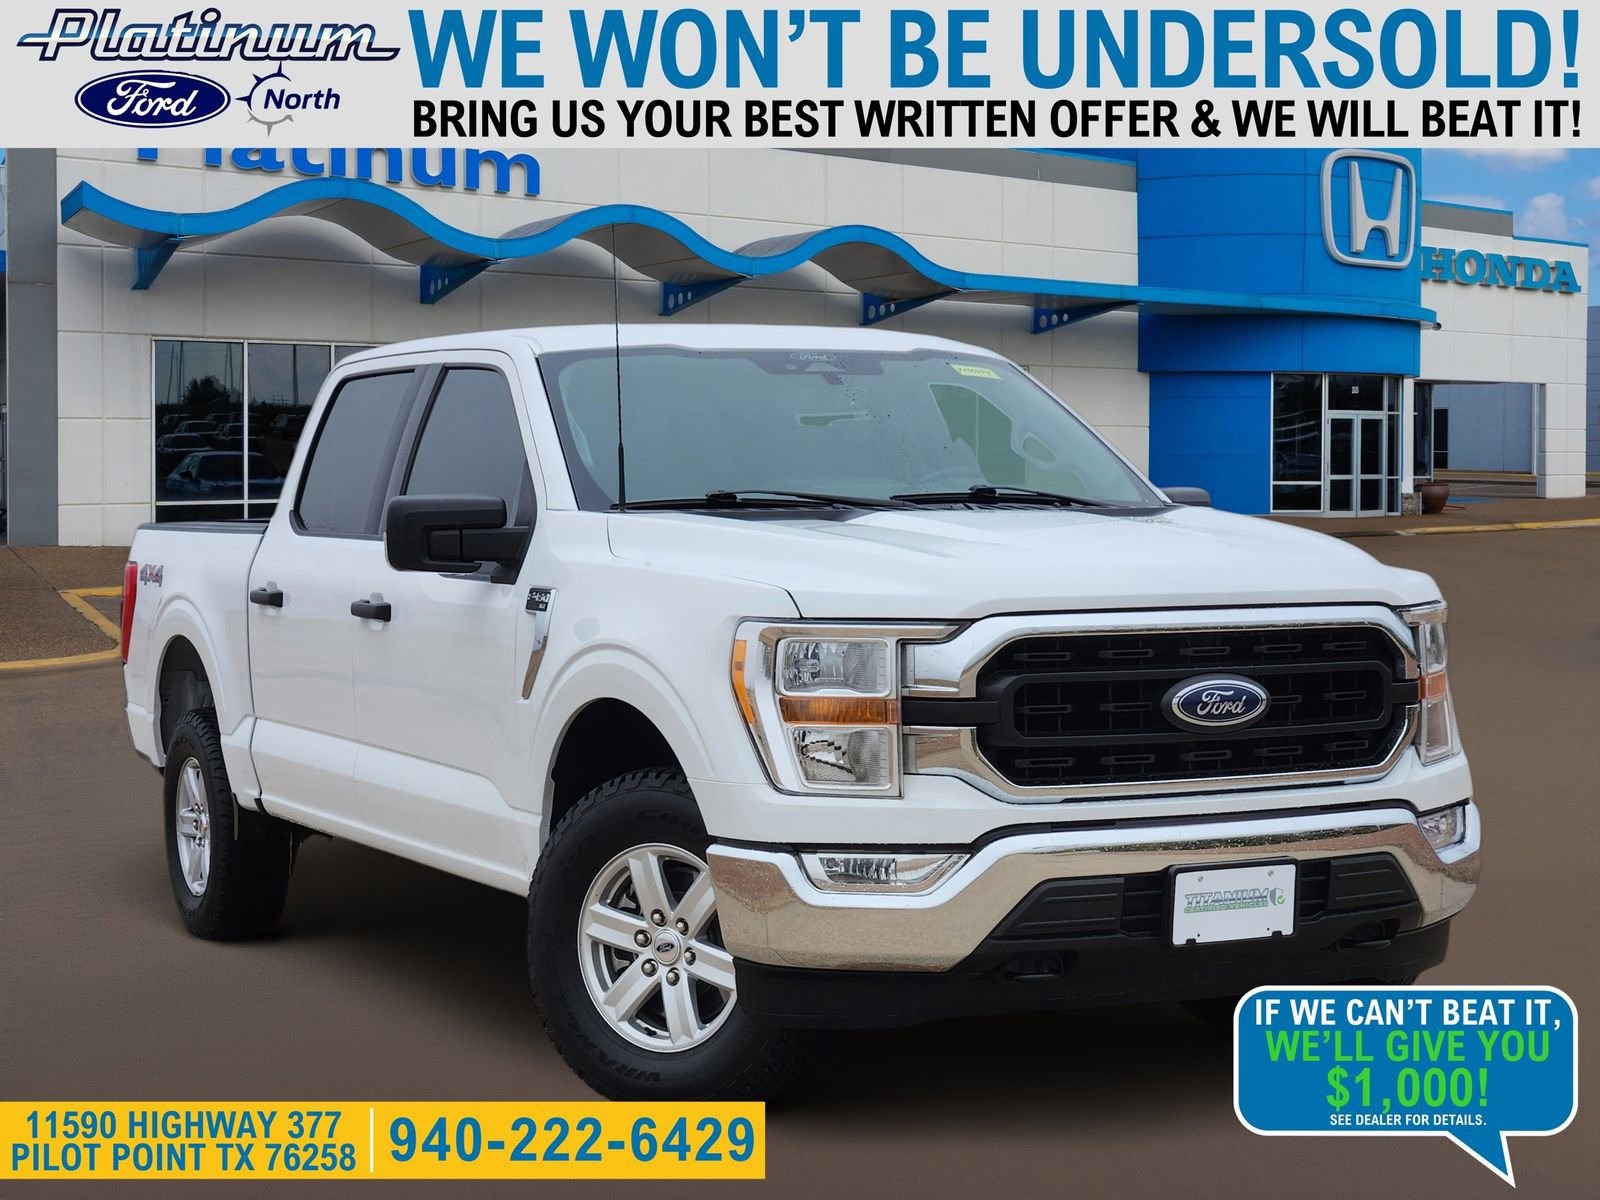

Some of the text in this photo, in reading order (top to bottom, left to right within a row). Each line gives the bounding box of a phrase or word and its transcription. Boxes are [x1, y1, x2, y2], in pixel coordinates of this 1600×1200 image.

[137, 148, 541, 196] atinum
[1421, 246, 1582, 294] HONDA
[1196, 690, 1247, 716] Ford
[1184, 888, 1270, 908] TITANIUM
